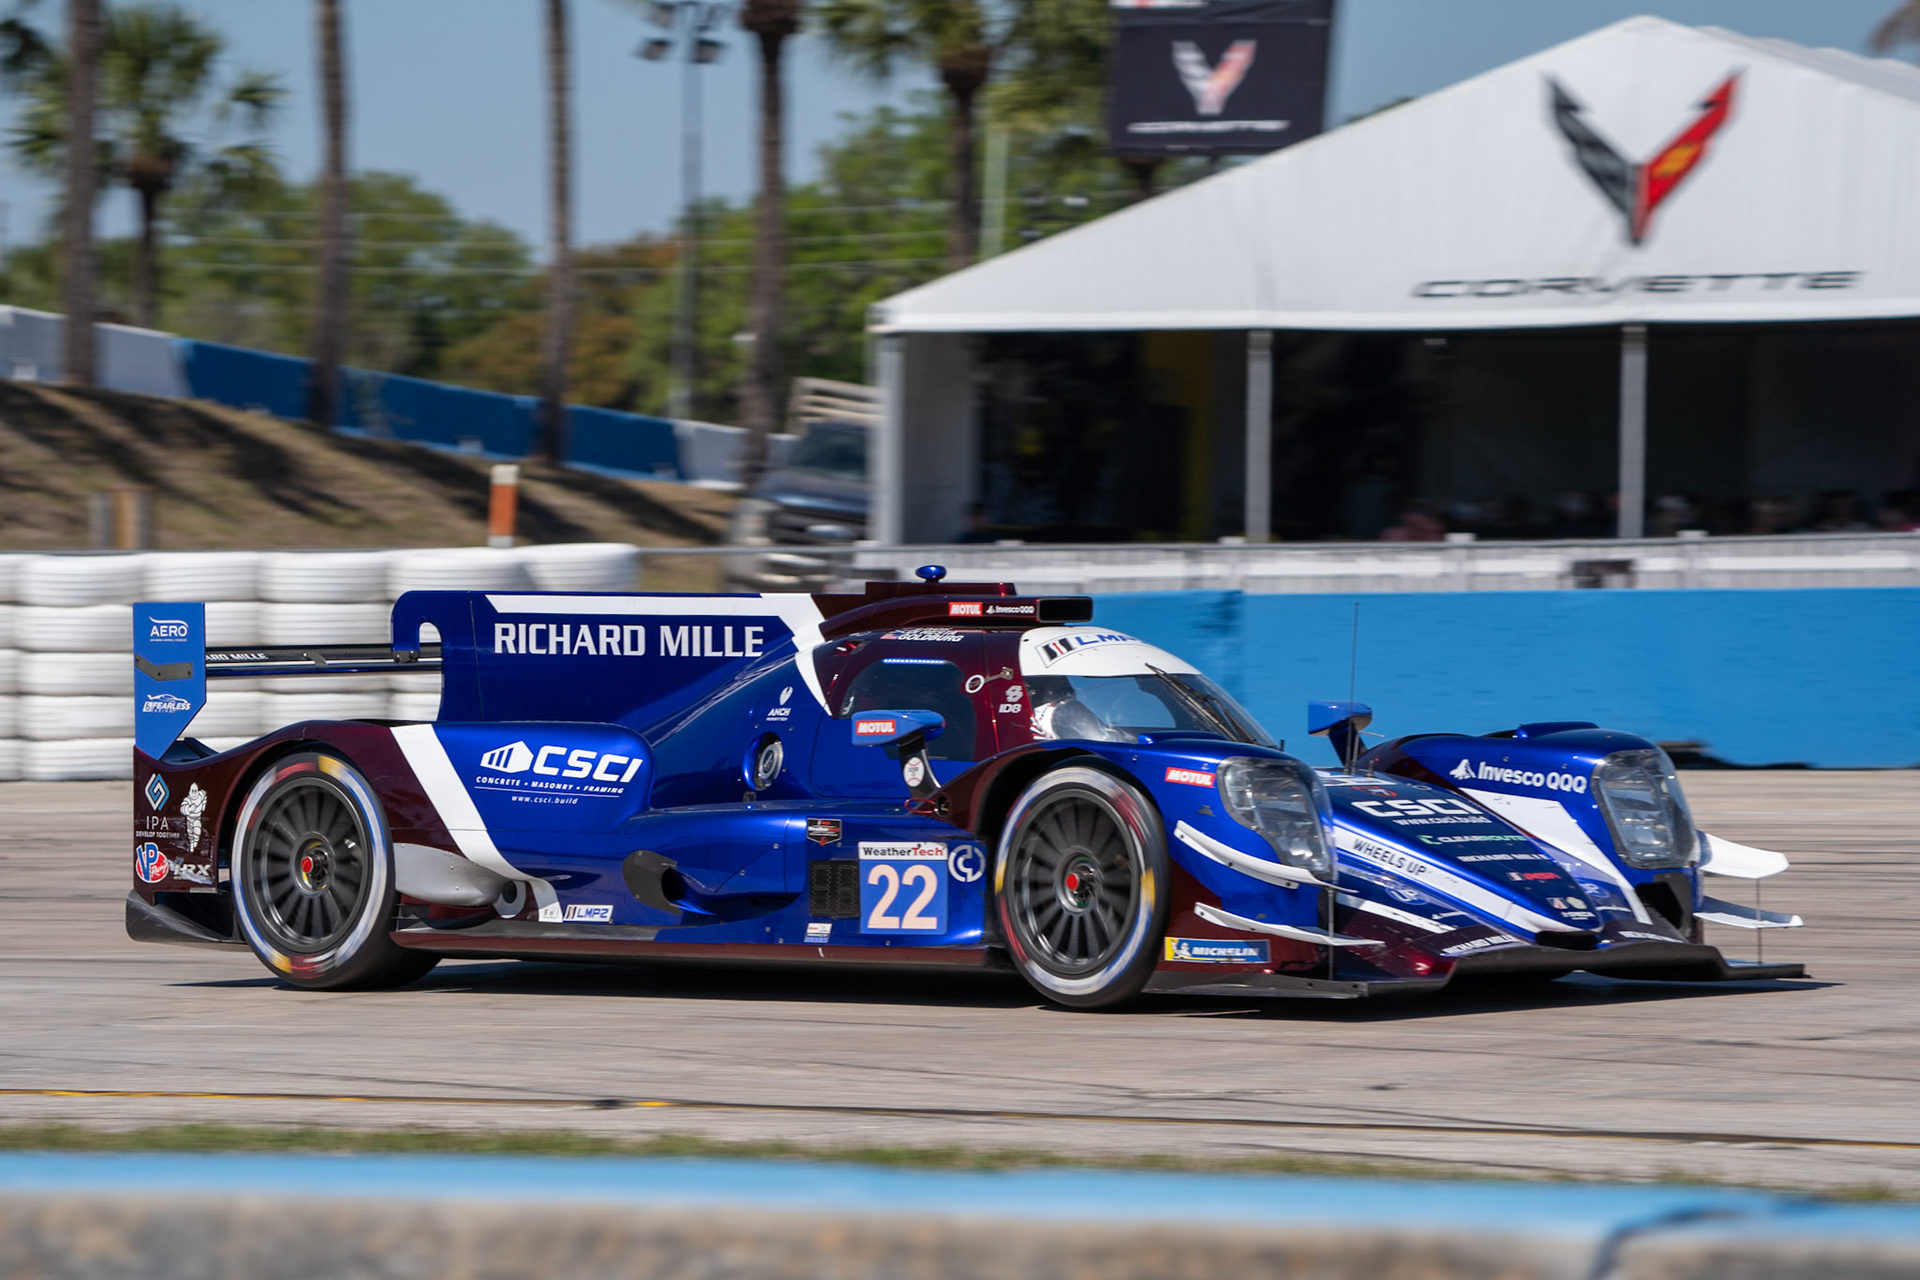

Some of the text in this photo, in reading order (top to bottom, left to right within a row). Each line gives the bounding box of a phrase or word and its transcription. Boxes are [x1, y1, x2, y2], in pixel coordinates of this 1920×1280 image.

[1412, 271, 1863, 298] CORVETTE
[950, 604, 981, 614] MOTUL
[150, 625, 188, 637] AERO
[494, 623, 764, 657] RICHARD MILLE
[230, 653, 269, 661] MILLE
[152, 701, 191, 711] FEARLESS
[857, 722, 895, 733] MOTUL
[533, 745, 643, 783] CSCI
[1167, 769, 1213, 785] MOTUL
[1478, 761, 1587, 794] Invesco QQQ
[475, 776, 625, 794] CONCRETE MASONRY FRAMING
[511, 795, 579, 805] www.csci.build
[1351, 799, 1484, 817] CSCI
[146, 816, 169, 830] IPA
[863, 847, 944, 856] WeatherTech
[1353, 838, 1427, 876] WHEELS UP
[136, 842, 159, 881] VP
[867, 864, 938, 930] 22
[577, 908, 609, 918] LMP2
[1191, 946, 1260, 956] MICHELIN
